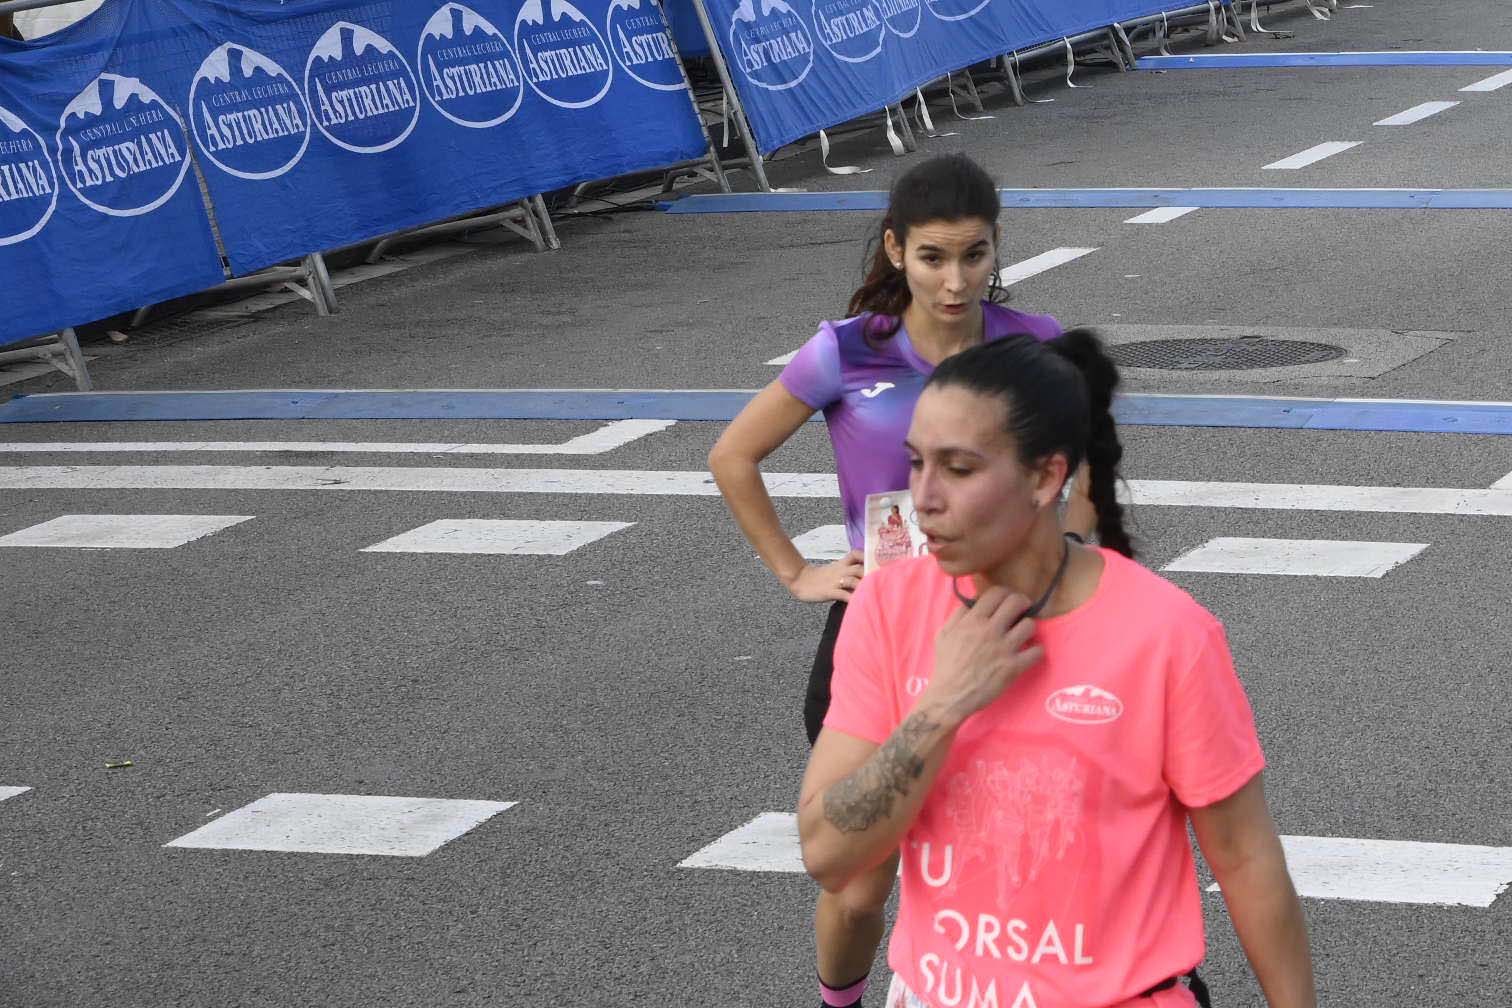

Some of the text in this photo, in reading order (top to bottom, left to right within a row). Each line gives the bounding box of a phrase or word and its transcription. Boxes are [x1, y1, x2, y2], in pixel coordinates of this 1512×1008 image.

[325, 60, 400, 84] CENTRAL LECHERA
[428, 53, 519, 102] ASTURIANA
[522, 37, 608, 83] ASTURIANA
[211, 81, 289, 107] CENTRAL LECHERA
[315, 76, 415, 126] ASTURIANA
[200, 99, 306, 153] ASTURIANA
